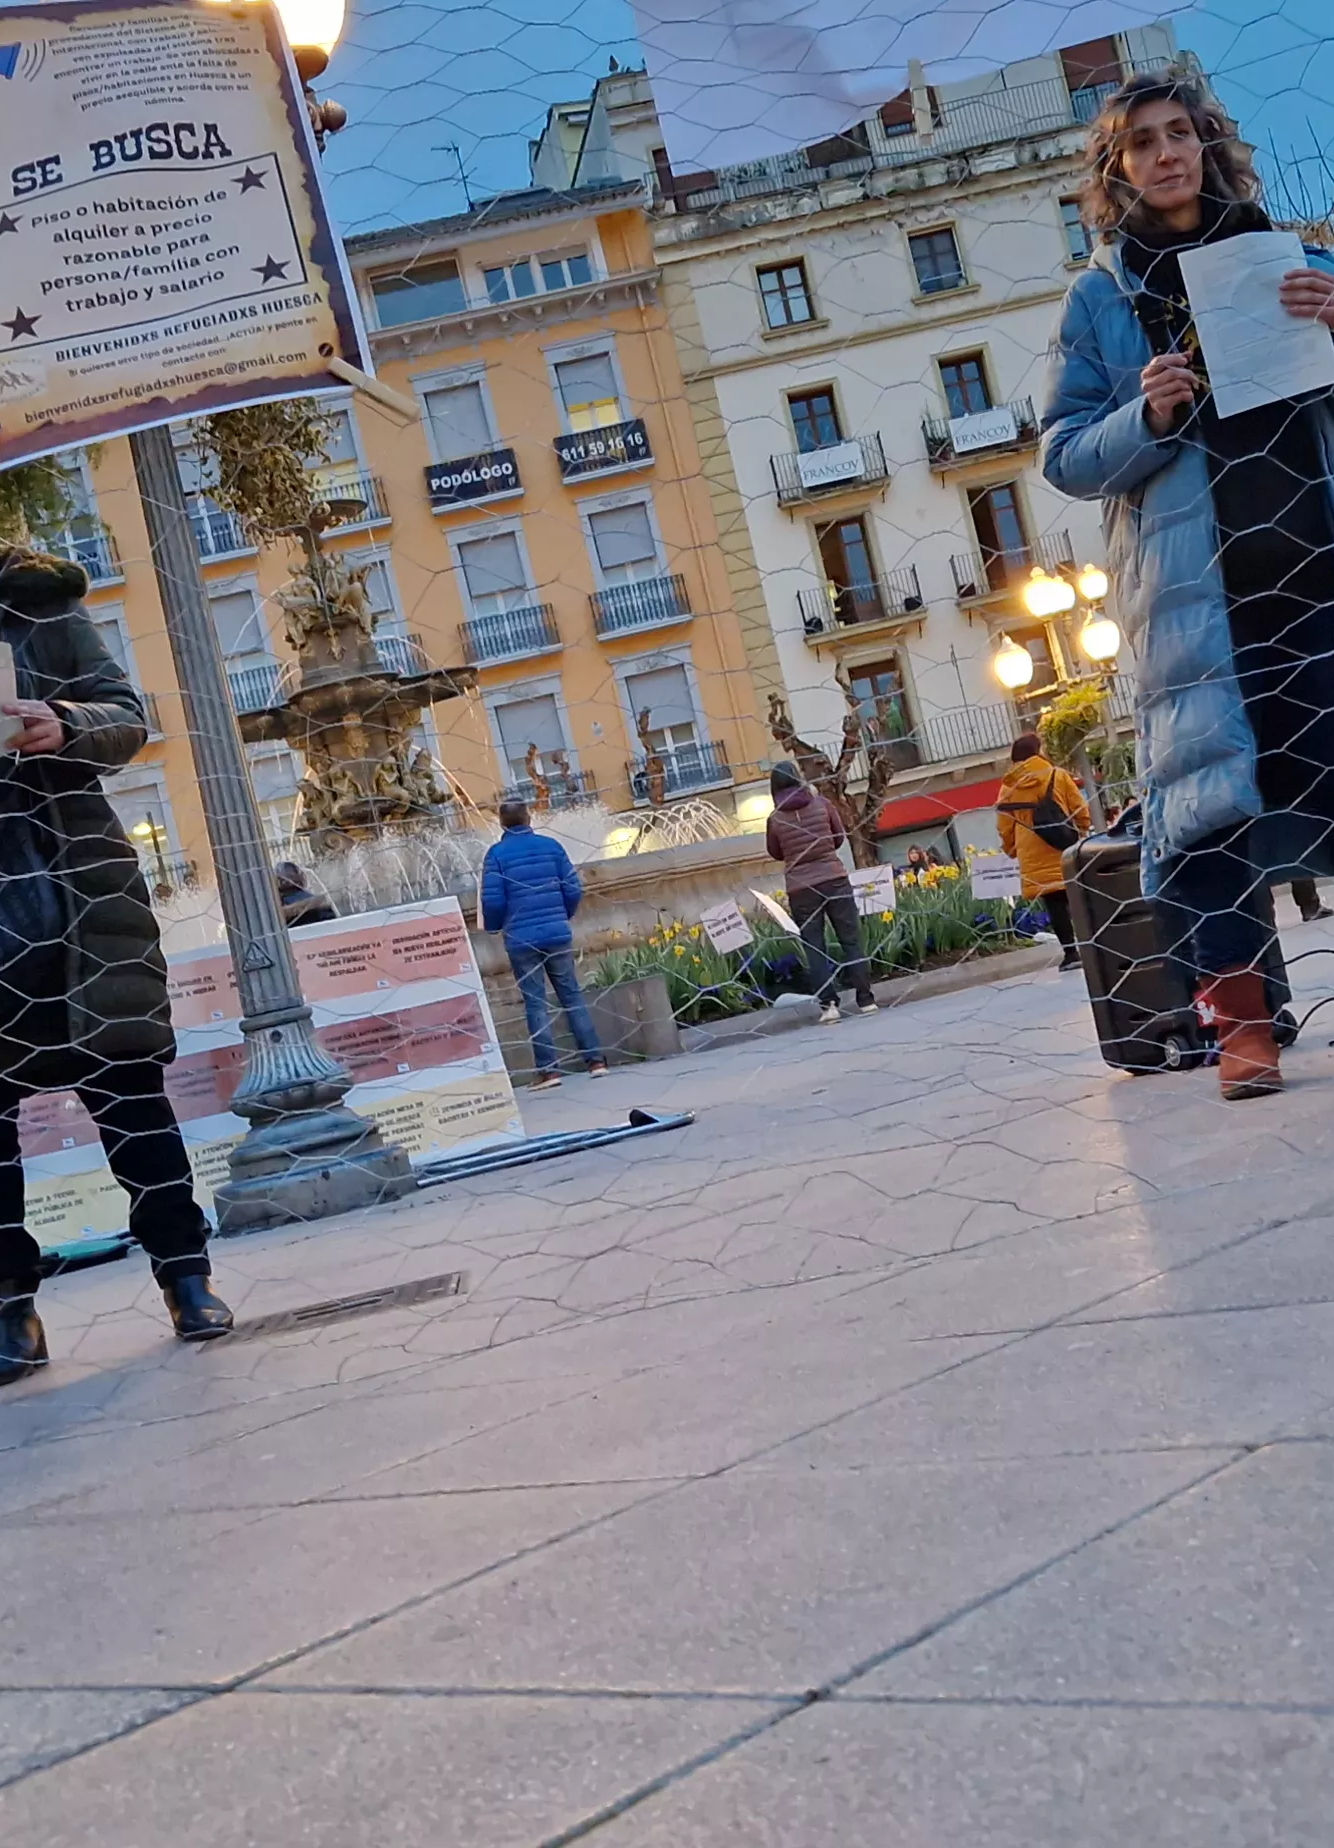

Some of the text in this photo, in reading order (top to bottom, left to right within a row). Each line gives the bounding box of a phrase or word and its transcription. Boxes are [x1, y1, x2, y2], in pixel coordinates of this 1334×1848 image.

[11, 121, 233, 198] SE BUSCA
[31, 188, 228, 228] Piso o habitación de
[53, 211, 213, 245] alquiler a precio
[63, 231, 211, 266] razonable para
[39, 243, 240, 296] persona/familia con
[65, 268, 225, 313] trabajo y salario
[55, 292, 323, 363] BIENVENIDXS REFUGIADXS HUESCA
[140, 349, 160, 361] tipo
[162, 345, 174, 355] de
[267, 322, 273, 333] y
[275, 316, 304, 333] ponte
[305, 314, 318, 325] en
[24, 351, 308, 425] bienvenidxsrefugiadxshuesca@gmail.com
[561, 442, 586, 462] 611
[589, 439, 605, 455] 59
[608, 436, 625, 451] 16
[627, 431, 644, 447] 16
[954, 423, 1012, 447] FRANCOY
[431, 462, 514, 491] PODÓLOGO
[803, 458, 859, 482] FRANCOY
